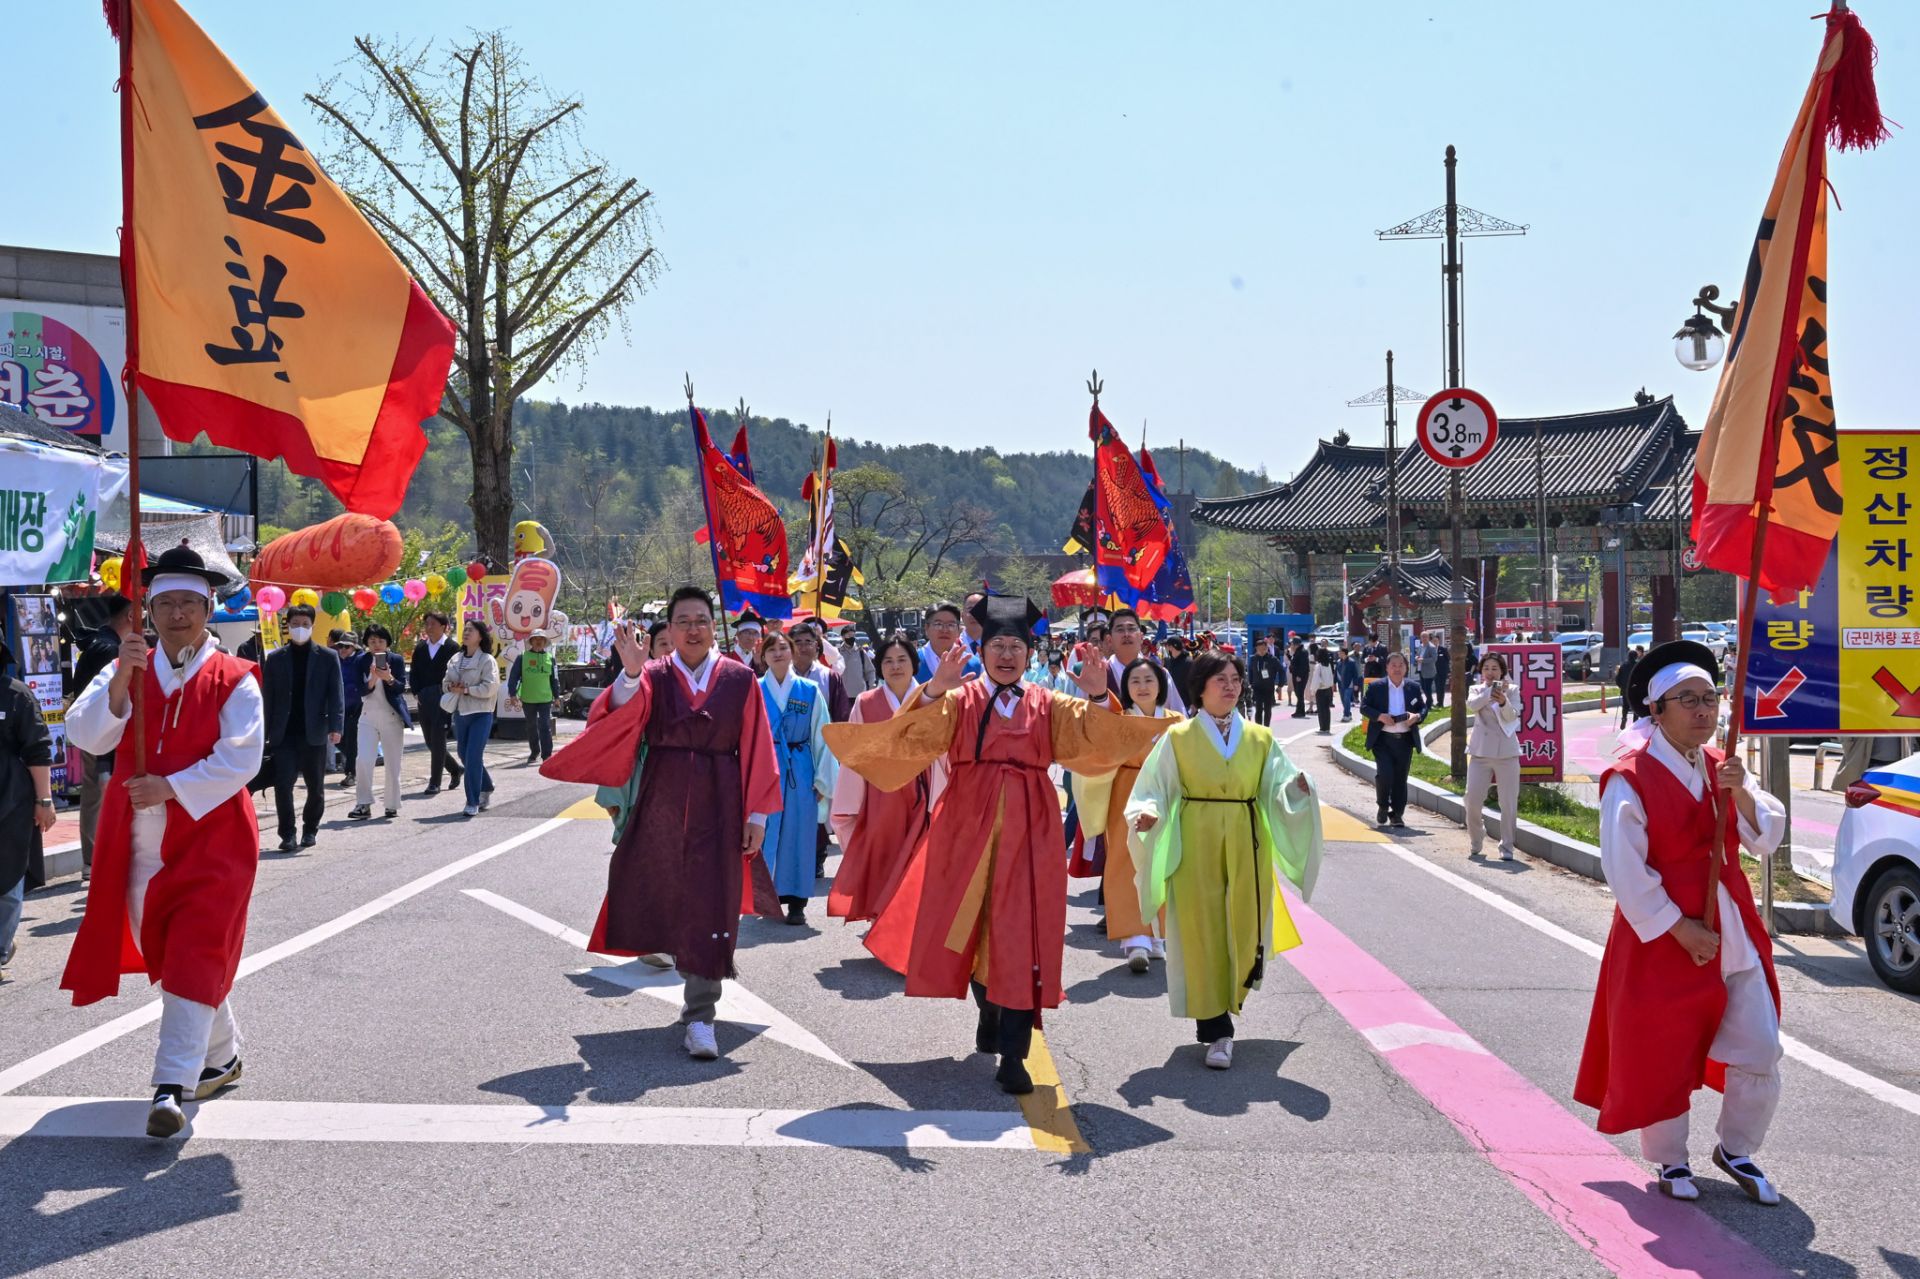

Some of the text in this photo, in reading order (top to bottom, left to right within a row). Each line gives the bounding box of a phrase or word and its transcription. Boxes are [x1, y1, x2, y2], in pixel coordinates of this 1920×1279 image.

[17, 345, 32, 358] 그
[35, 345, 66, 361] 시절,
[1433, 412, 1482, 444] 3.8m
[1863, 446, 1913, 619] 정산차량
[1846, 631, 1897, 646] (군민차량
